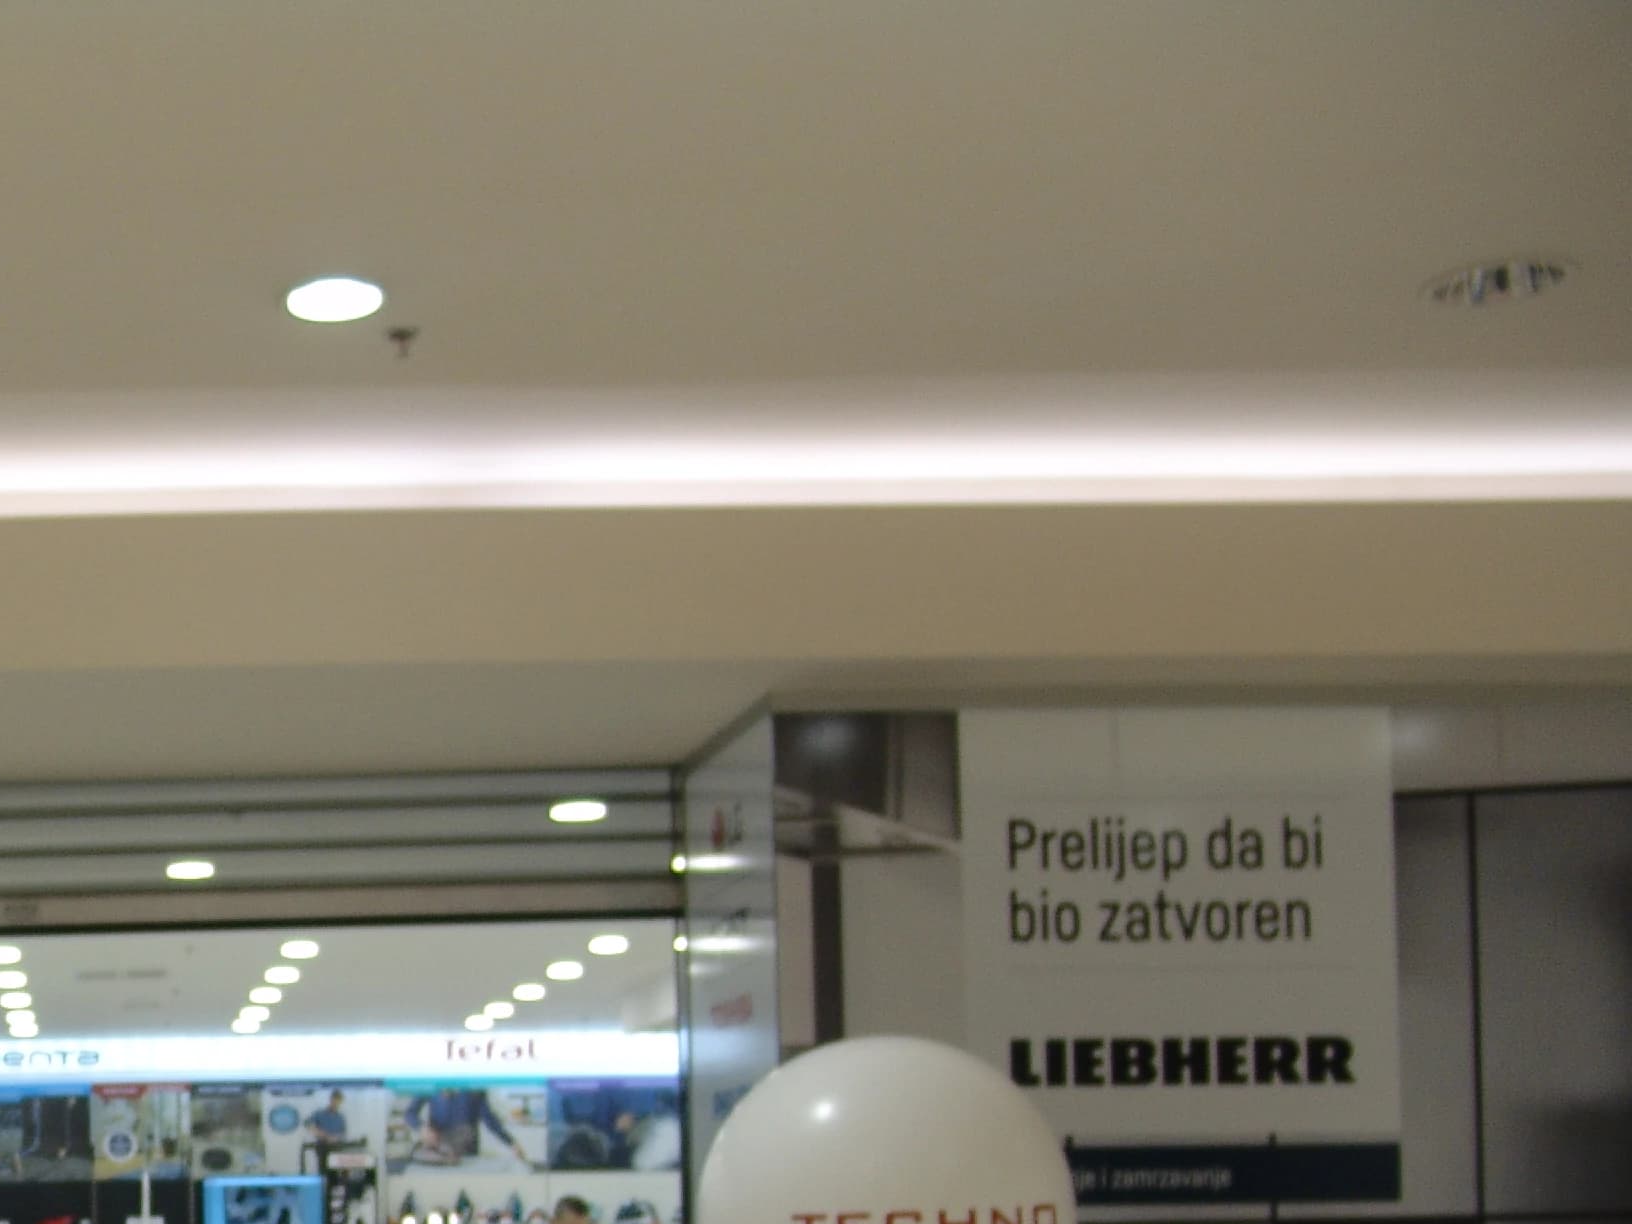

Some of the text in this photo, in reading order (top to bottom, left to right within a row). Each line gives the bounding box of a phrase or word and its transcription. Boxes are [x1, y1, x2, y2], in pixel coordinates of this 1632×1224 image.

[1007, 814, 1324, 882] Prelijep da bi
[1009, 889, 1313, 943] bio zatvoren
[1009, 1034, 1356, 1087] LIEBHERR
